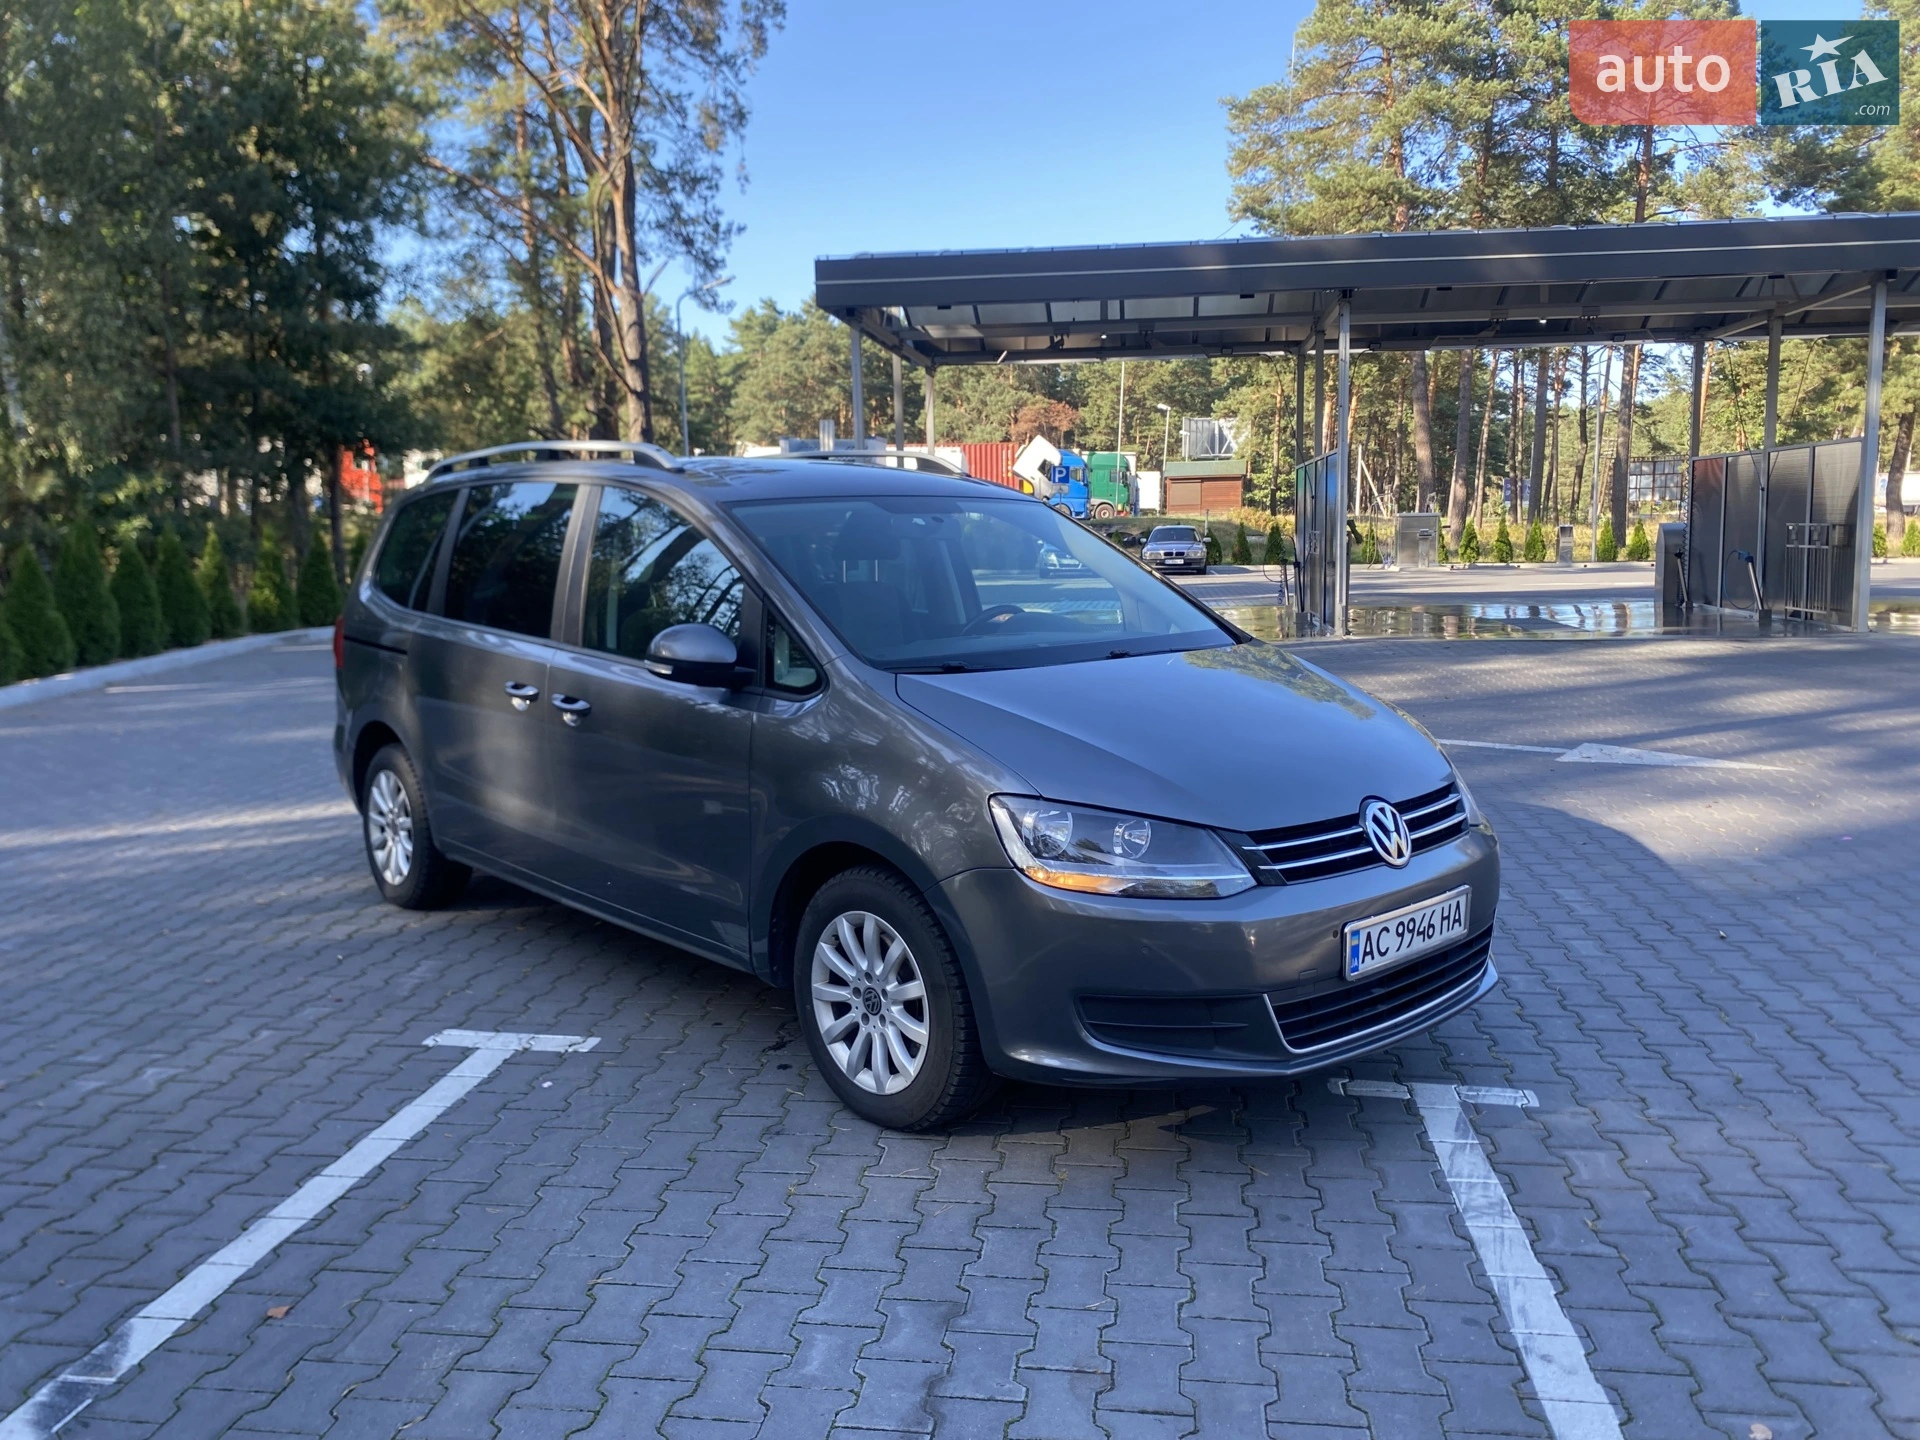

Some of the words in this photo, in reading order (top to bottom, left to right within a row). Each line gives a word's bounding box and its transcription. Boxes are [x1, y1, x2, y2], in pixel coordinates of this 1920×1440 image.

[1054, 467, 1067, 483] P
[1361, 926, 1390, 965] AC
[1395, 909, 1436, 953] 9946
[1439, 900, 1462, 935] HA
